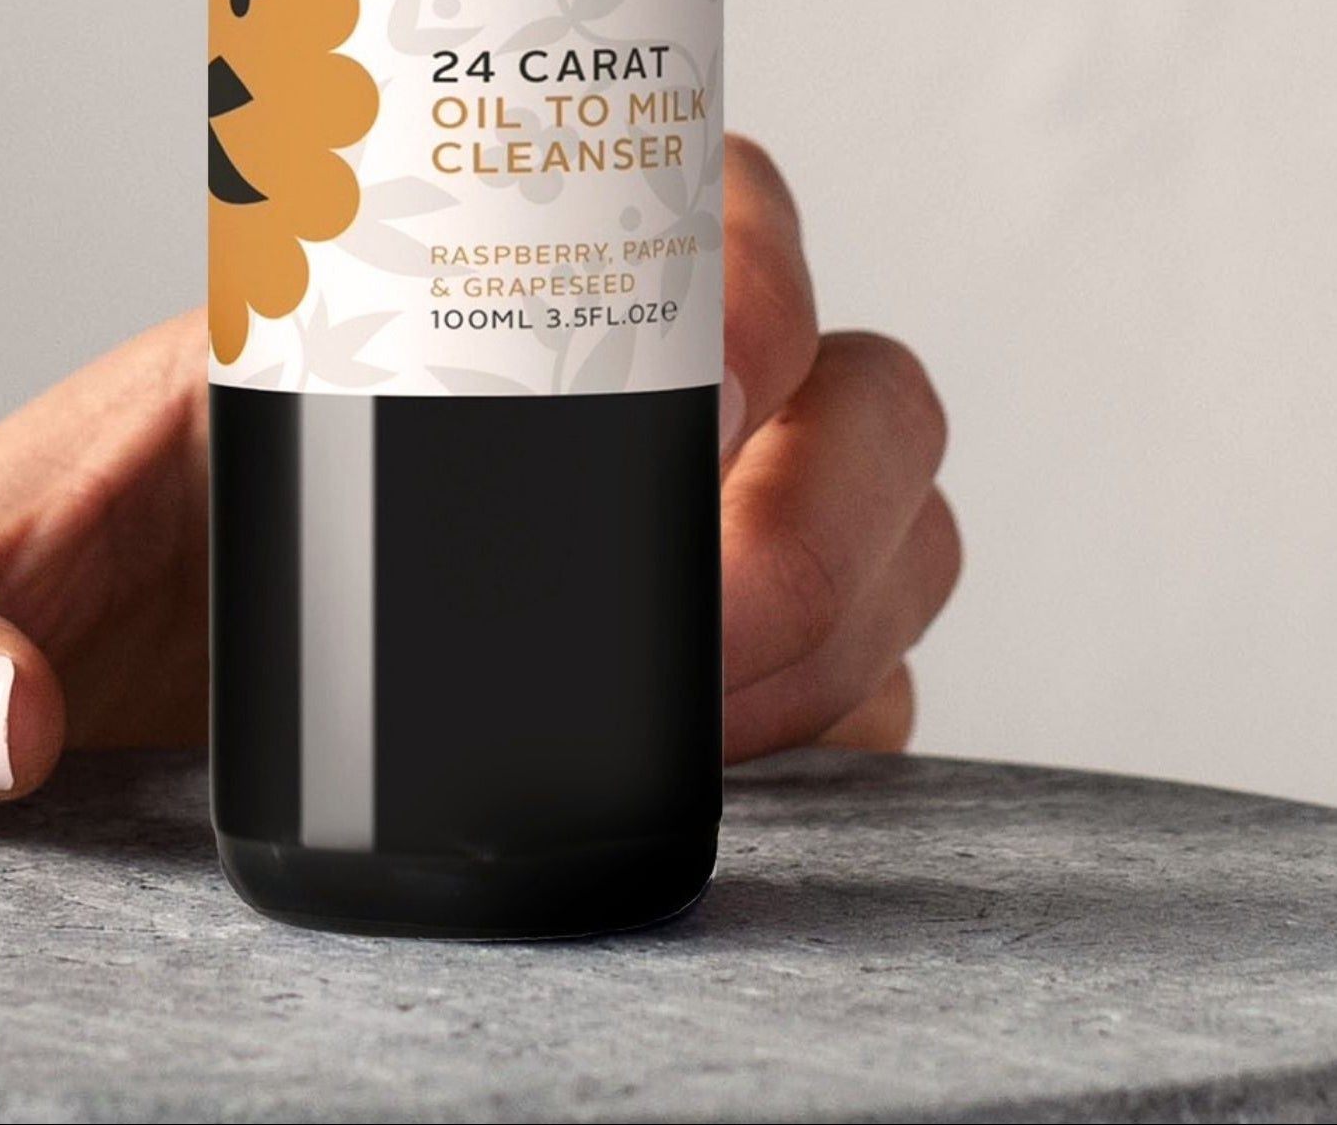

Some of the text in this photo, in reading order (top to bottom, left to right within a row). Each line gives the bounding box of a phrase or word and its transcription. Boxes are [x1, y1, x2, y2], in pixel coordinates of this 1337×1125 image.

[432, 46, 670, 83] 24 CARAT
[431, 87, 707, 129] OIL TO MILK
[431, 134, 684, 174] CLEANSER
[430, 235, 698, 265] RASPBERRY, PAPAYA
[430, 273, 636, 298] & GRAPESEED
[430, 309, 534, 330] 100ML
